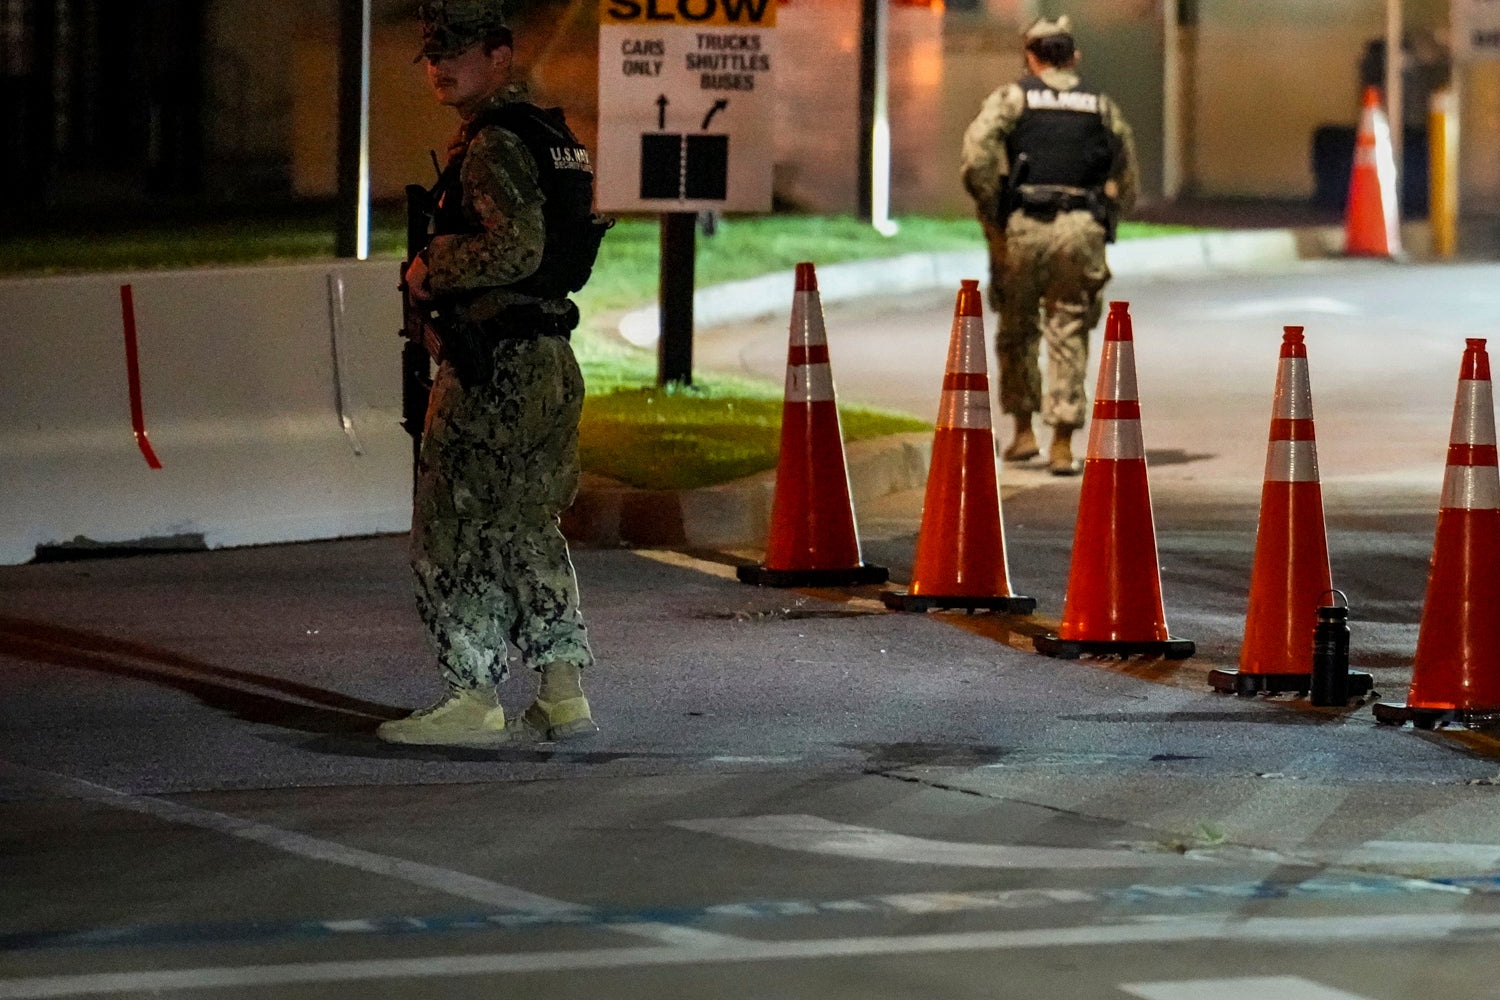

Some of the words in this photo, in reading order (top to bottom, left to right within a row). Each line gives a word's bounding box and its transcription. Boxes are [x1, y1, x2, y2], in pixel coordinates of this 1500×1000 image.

[621, 38, 665, 56] CARS
[696, 33, 761, 51] TRUCKS
[622, 59, 663, 77] ONLY
[685, 52, 770, 72] SHUTTLES
[700, 73, 755, 91] BUSES
